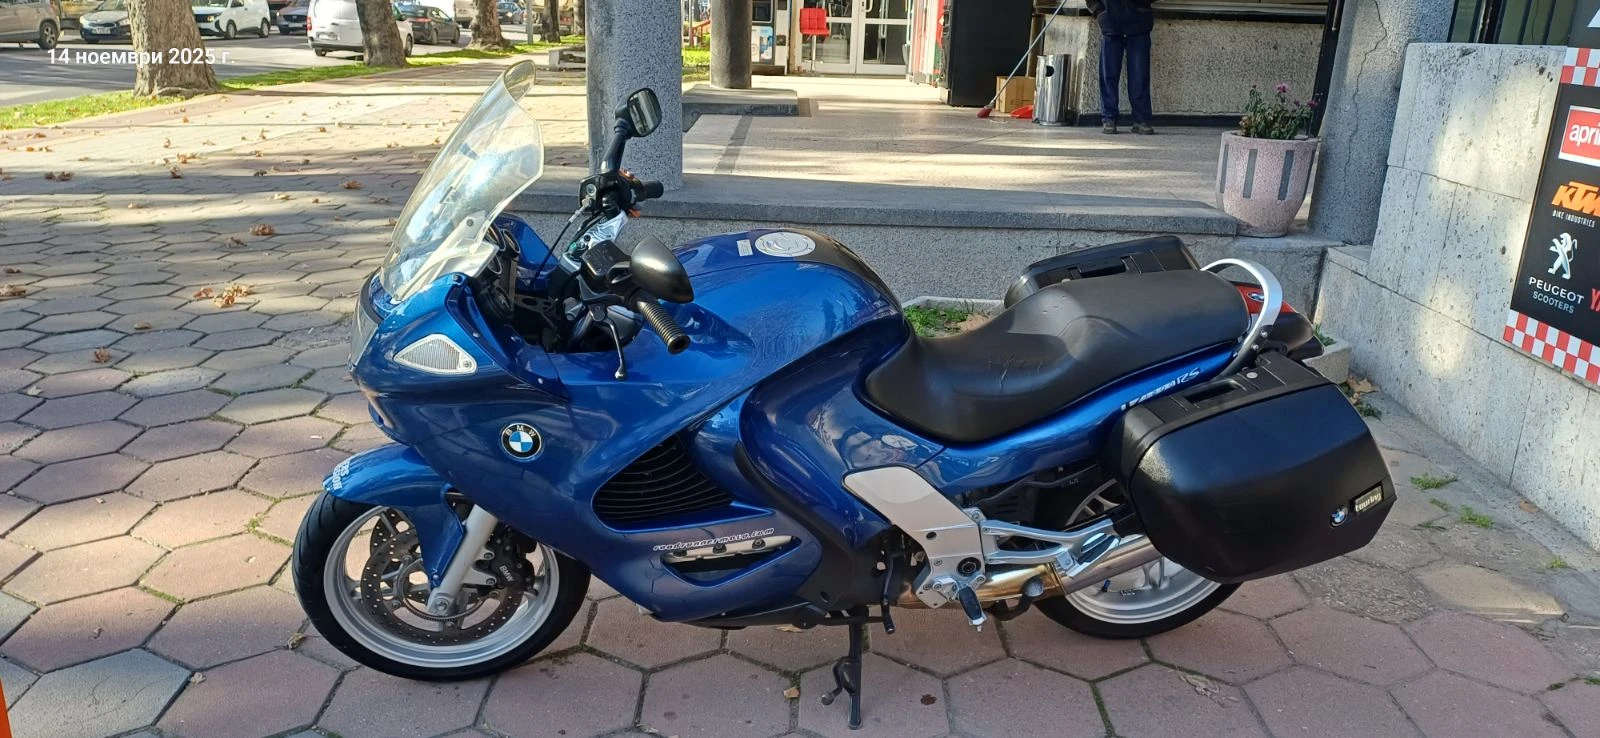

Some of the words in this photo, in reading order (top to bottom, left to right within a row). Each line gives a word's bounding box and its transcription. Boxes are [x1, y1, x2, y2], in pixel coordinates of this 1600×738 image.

[1552, 209, 1565, 221] BIKE
[1565, 212, 1596, 228] INDUSTRIES
[1528, 276, 1585, 305] PEUGEOT
[1532, 290, 1575, 314] SCOOTERS
[504, 424, 537, 437] BMW
[652, 527, 775, 551] roadrunnermoto.com
[499, 564, 515, 583] BMW
